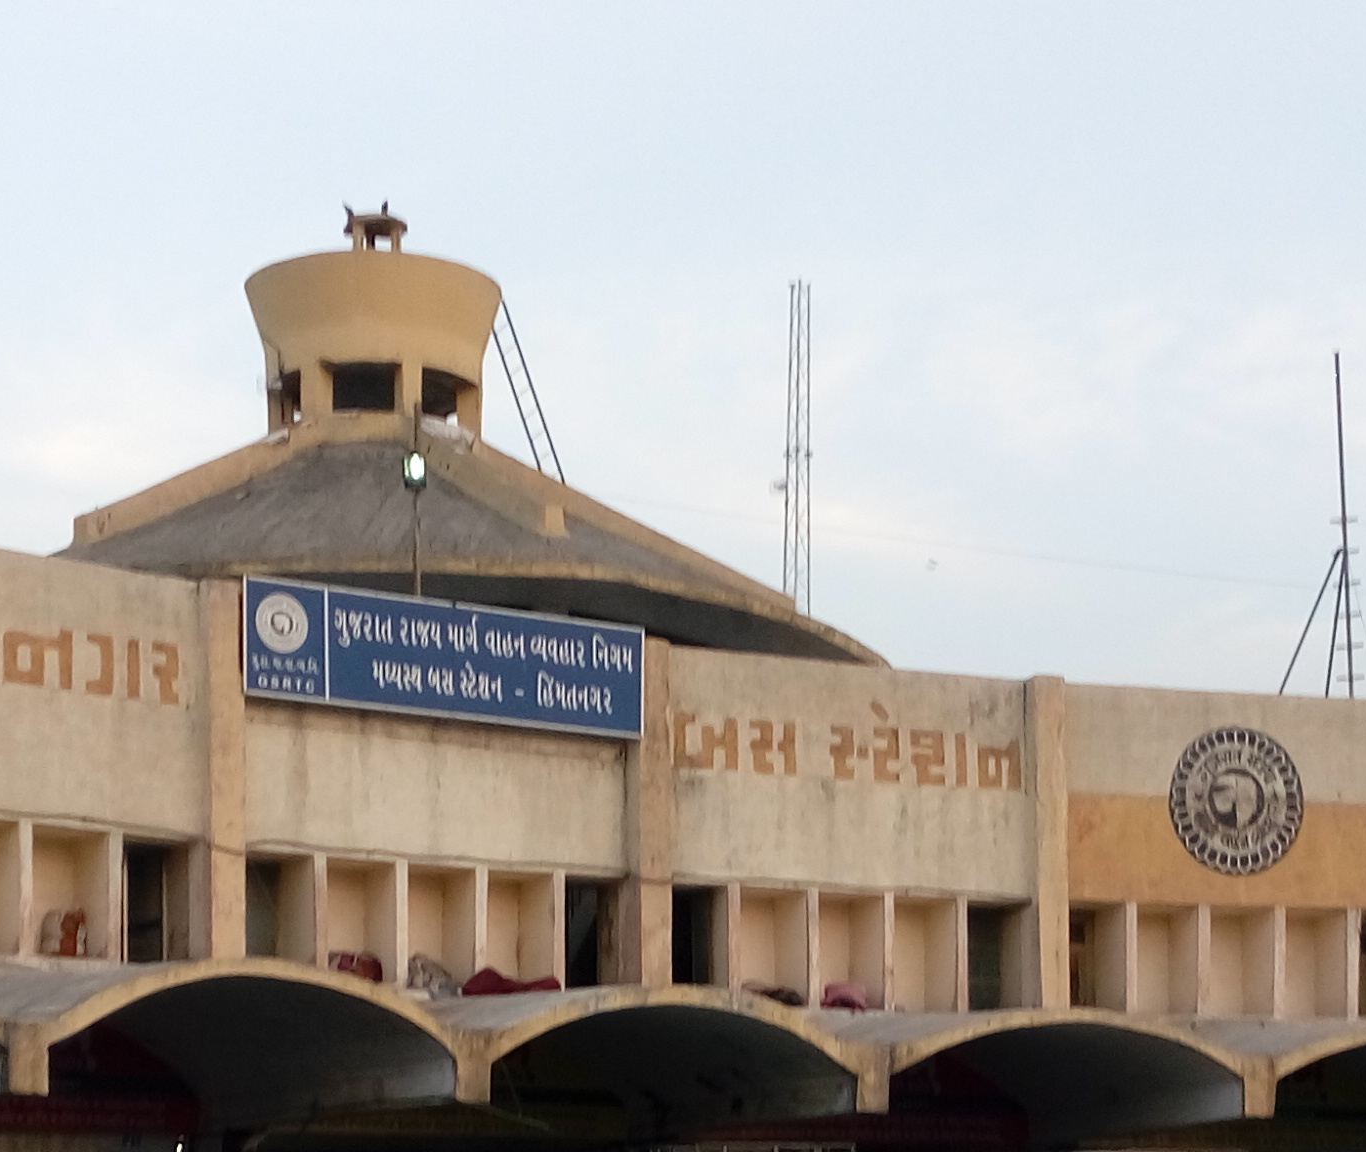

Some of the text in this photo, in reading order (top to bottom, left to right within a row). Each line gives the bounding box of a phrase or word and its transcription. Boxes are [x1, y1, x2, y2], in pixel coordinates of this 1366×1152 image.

[334, 607, 393, 648] ગુજરાત
[447, 613, 479, 654] માર્ગ
[484, 628, 527, 661] વાહન
[592, 632, 633, 674] નિગમ
[428, 664, 455, 697] બસ
[460, 660, 503, 703] સ્ટેશન
